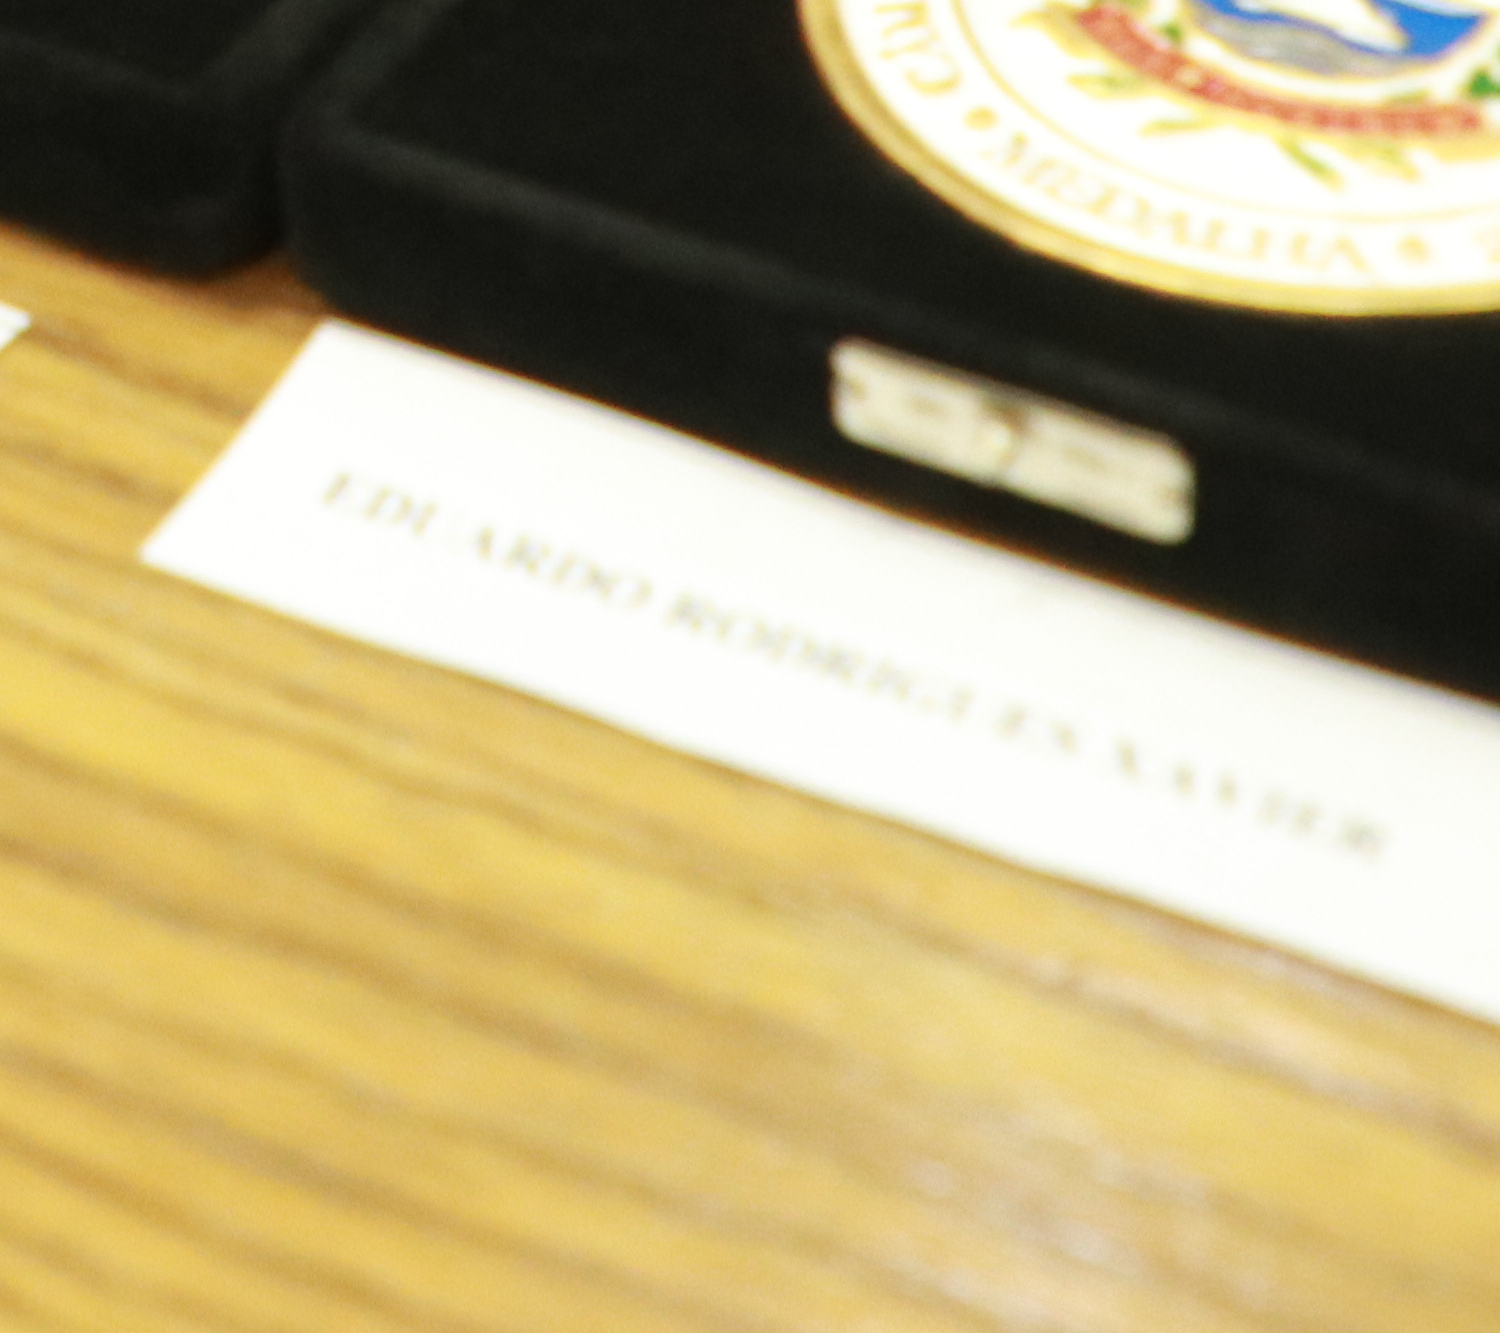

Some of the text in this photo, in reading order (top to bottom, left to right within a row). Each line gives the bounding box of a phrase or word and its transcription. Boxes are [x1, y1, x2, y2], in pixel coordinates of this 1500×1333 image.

[318, 468, 1396, 867] EDUARDO RODRIGUES XAVIER
